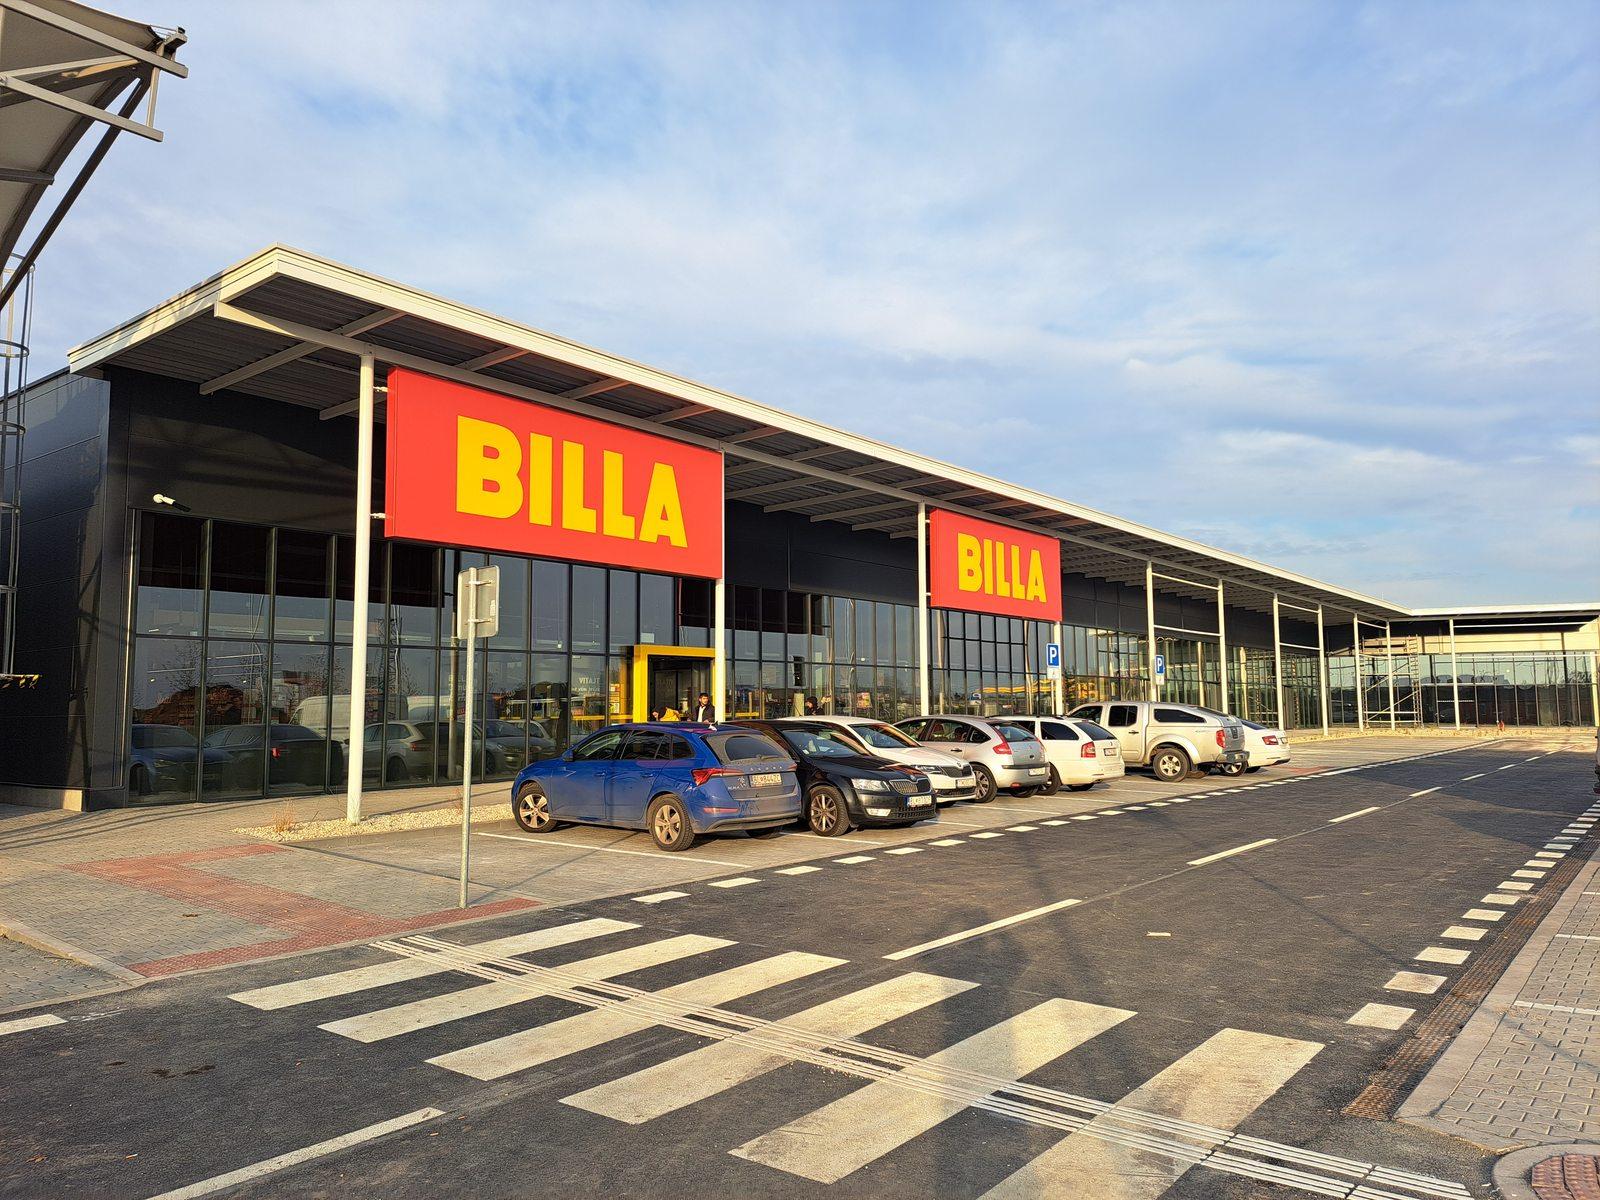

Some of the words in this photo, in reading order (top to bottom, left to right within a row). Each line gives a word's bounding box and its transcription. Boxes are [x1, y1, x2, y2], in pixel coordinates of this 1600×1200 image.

[456, 415, 688, 548] BILLA
[957, 532, 1047, 603] BILLA
[1049, 646, 1057, 663] P
[1157, 658, 1163, 672] P
